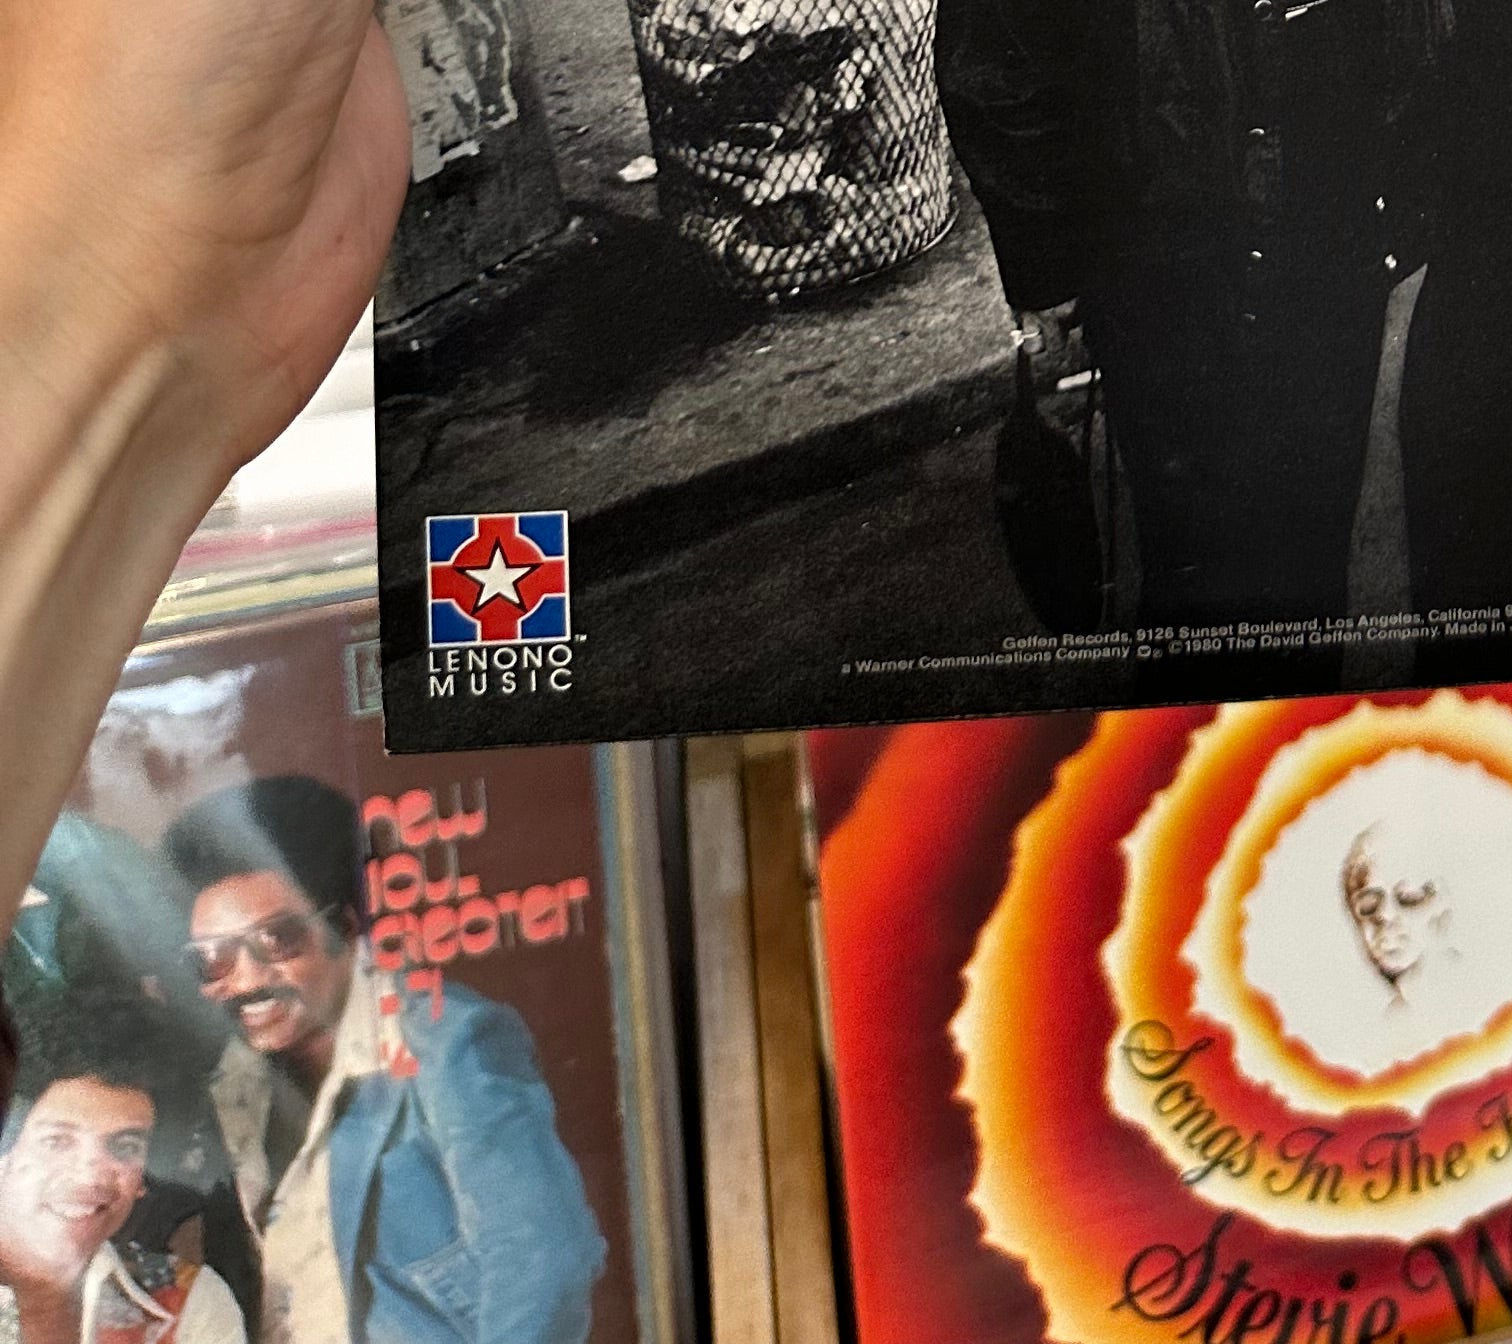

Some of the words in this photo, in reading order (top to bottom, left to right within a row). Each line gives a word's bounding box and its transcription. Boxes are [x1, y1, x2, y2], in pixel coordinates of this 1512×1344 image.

[429, 644, 573, 673] LENONO
[429, 668, 573, 697] MUSIC
[1120, 1019, 1266, 1186] Songs
[1262, 1127, 1342, 1204] In
[1357, 1128, 1471, 1204] The
[1110, 1211, 1405, 1344] Stevie
